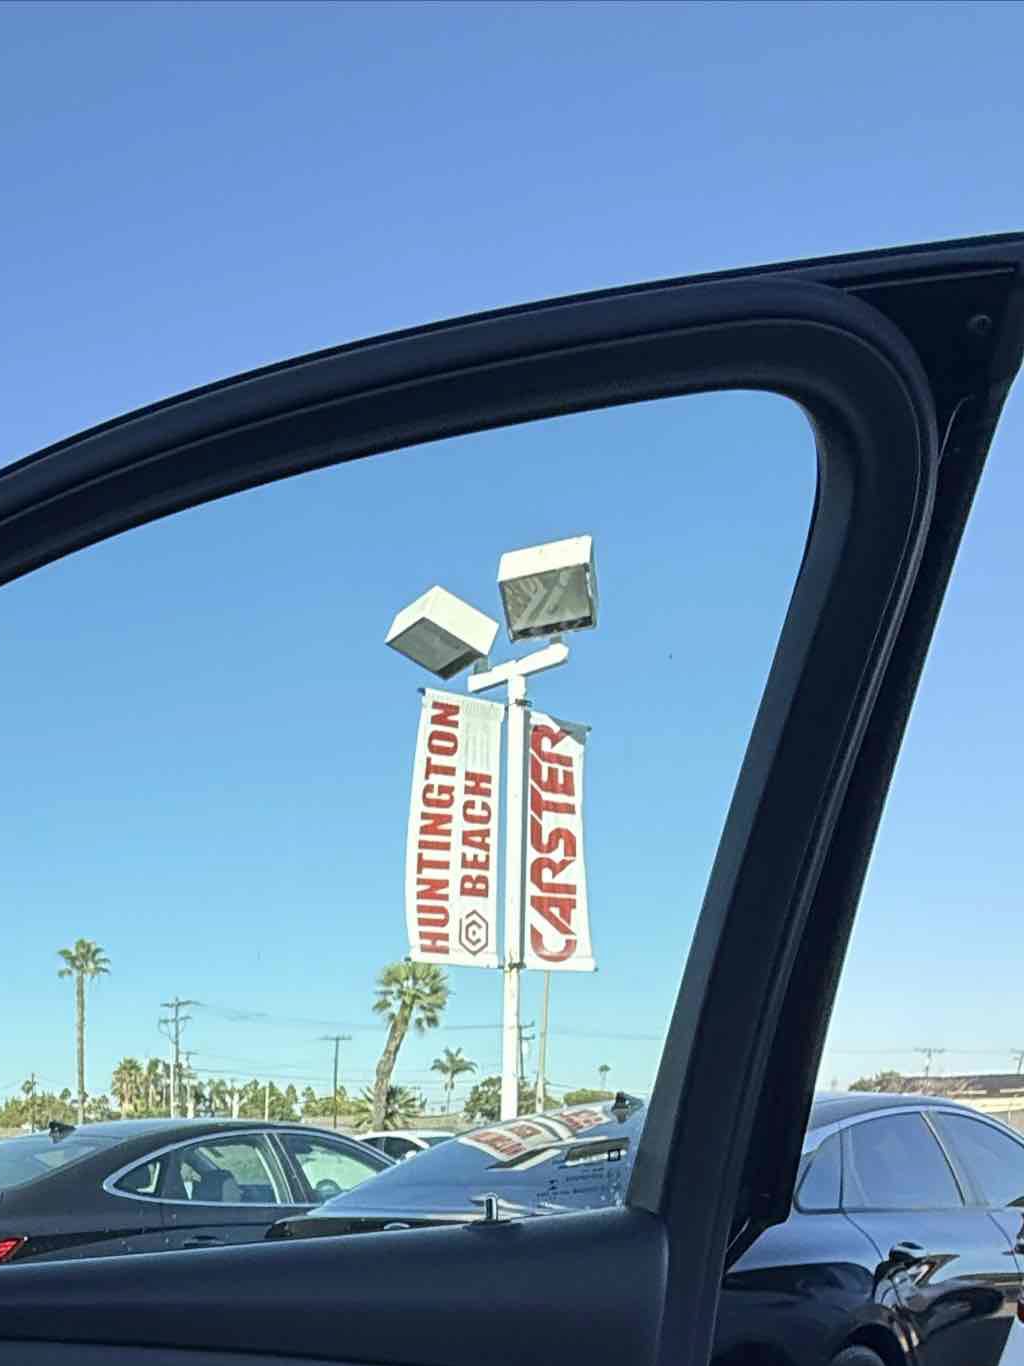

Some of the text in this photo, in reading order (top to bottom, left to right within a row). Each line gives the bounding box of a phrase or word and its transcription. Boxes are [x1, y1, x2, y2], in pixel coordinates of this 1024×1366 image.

[417, 702, 460, 954] HUNTINGTON
[460, 771, 492, 898] BEACH
[530, 723, 577, 962] CARSTER
